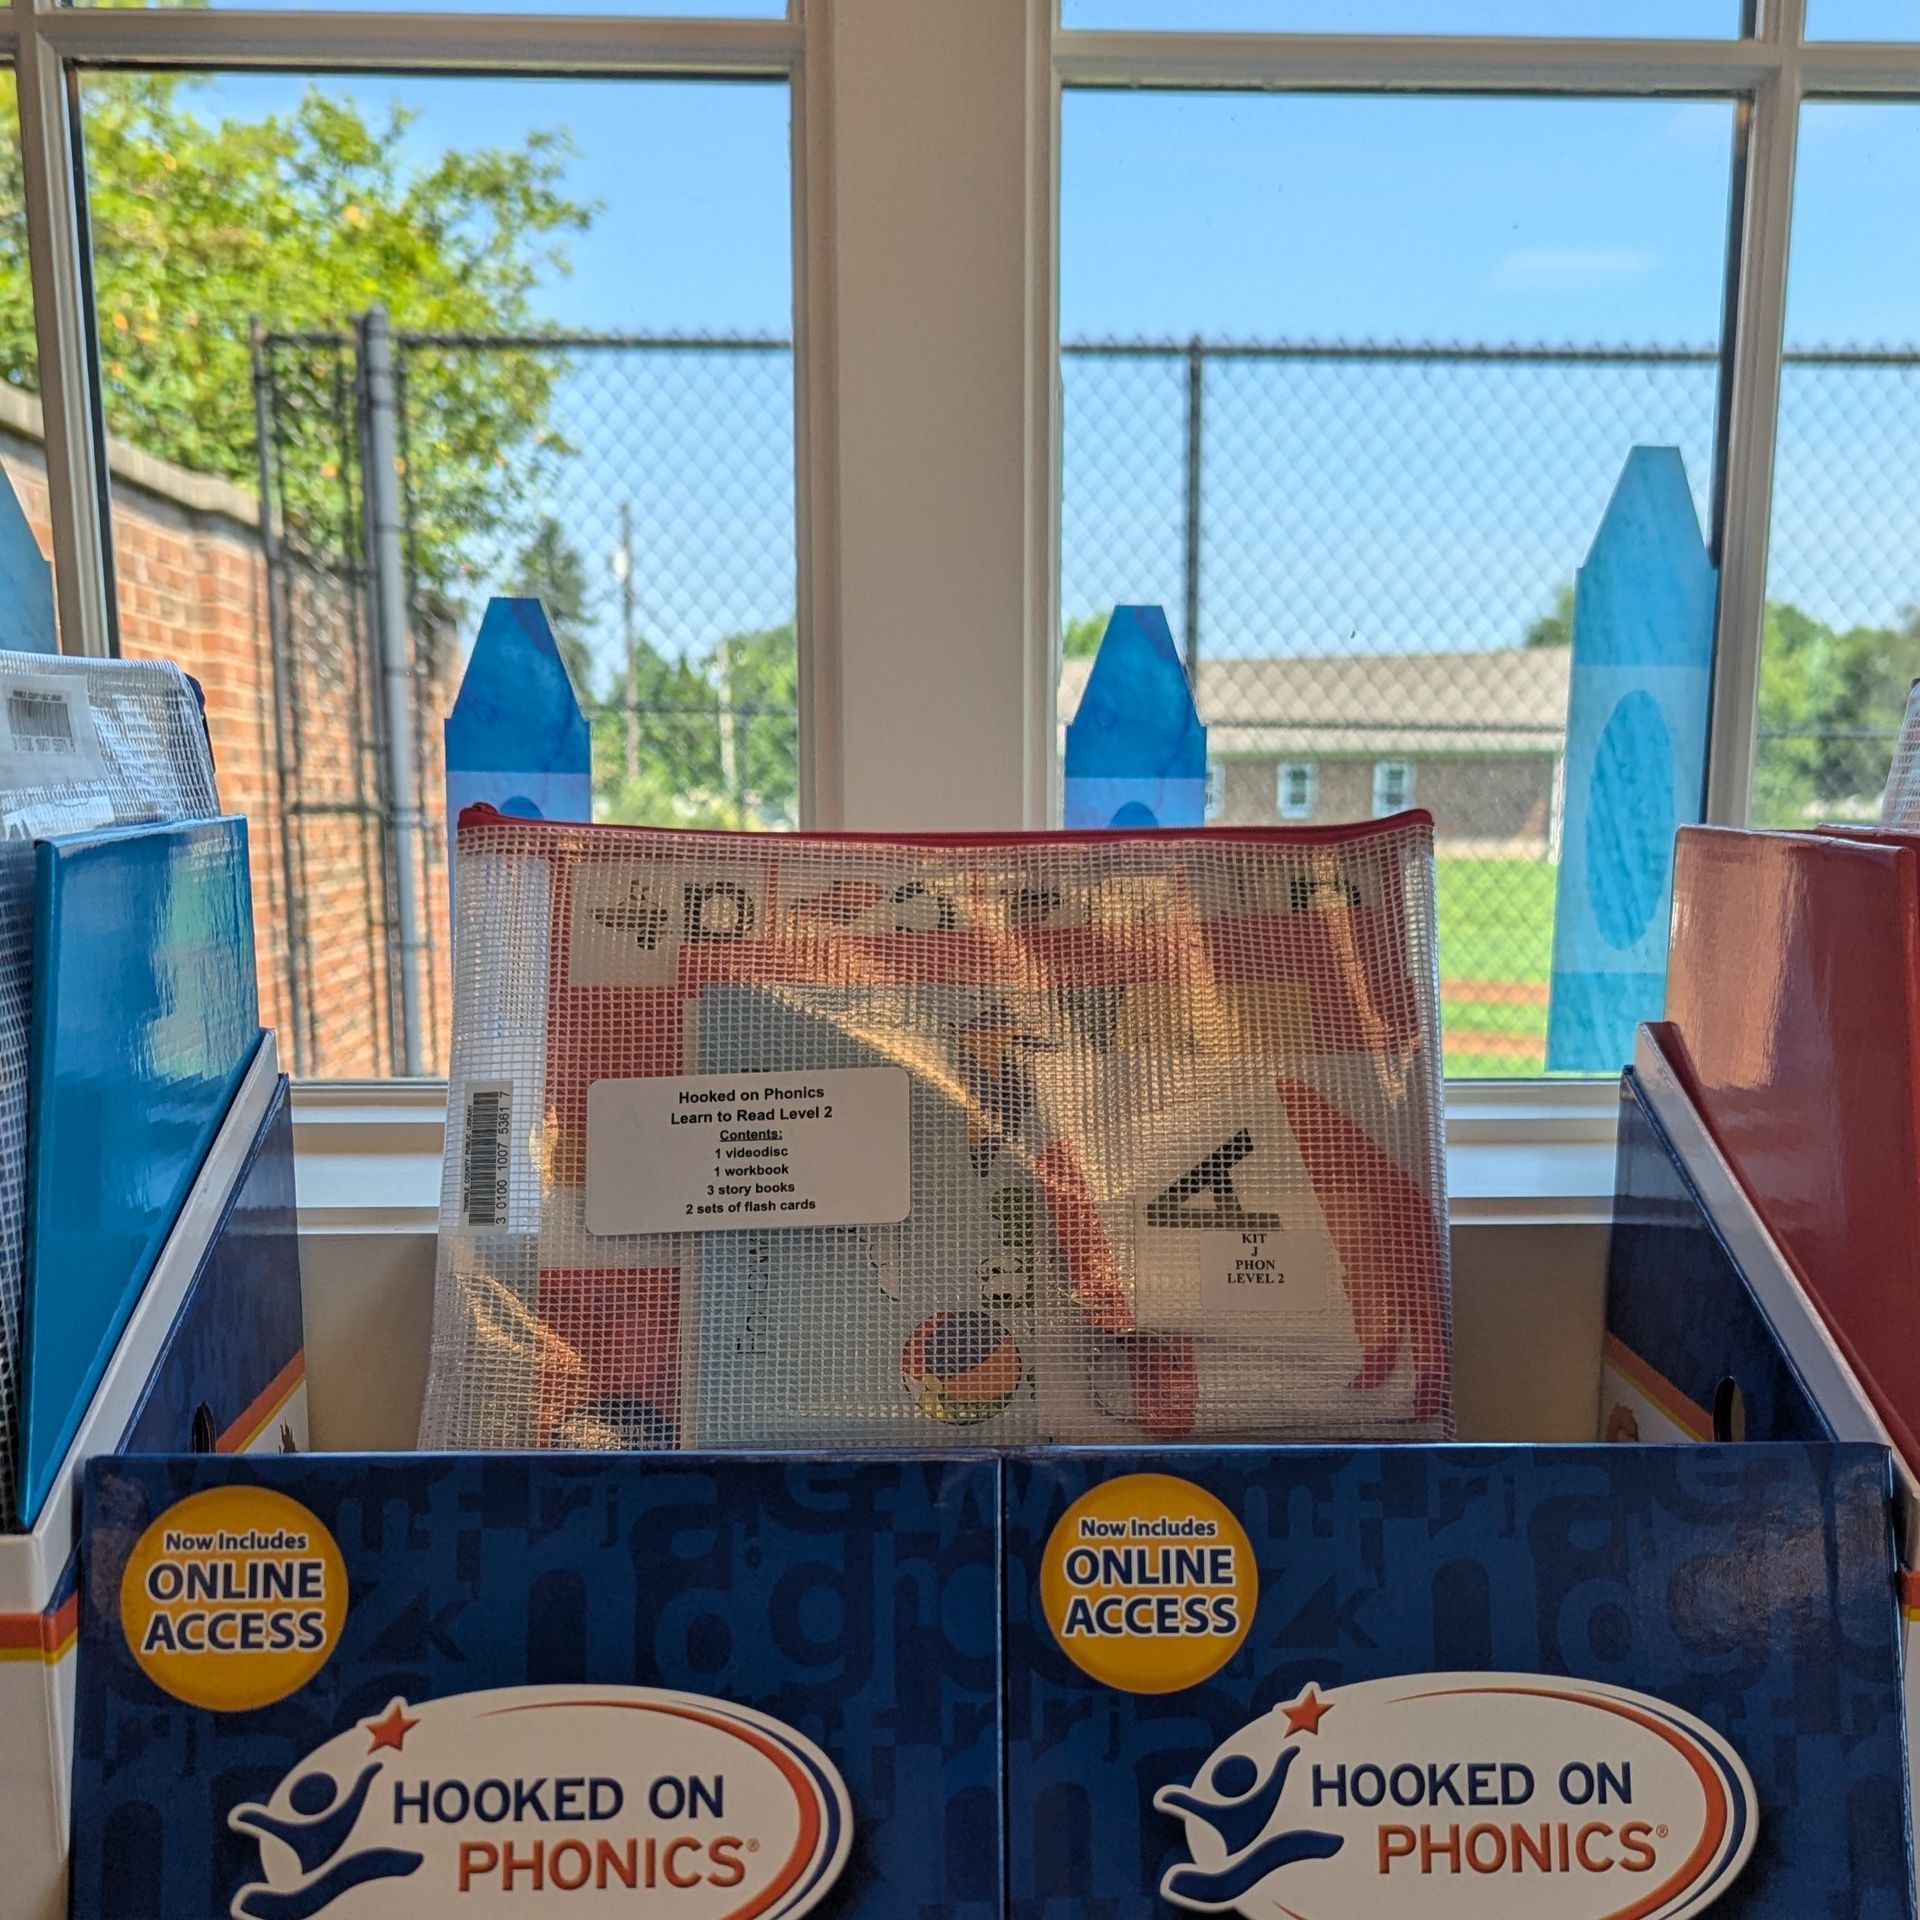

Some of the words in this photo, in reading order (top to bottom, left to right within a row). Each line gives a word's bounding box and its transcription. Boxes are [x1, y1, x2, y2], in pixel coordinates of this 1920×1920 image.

[499, 1091, 510, 1099] 7
[679, 1089, 736, 1104] Hooked
[740, 1091, 759, 1101] on
[764, 1086, 824, 1100] Phonics
[499, 1106, 509, 1134] 5361
[671, 1112, 713, 1125] Learn
[717, 1111, 732, 1122] to
[737, 1108, 775, 1122] Read
[780, 1106, 819, 1120] Level
[824, 1106, 833, 1118] 2
[720, 1129, 783, 1142] Contents:
[498, 1142, 508, 1171] 1007
[715, 1148, 721, 1159] 1
[725, 1146, 789, 1159] videodisc
[714, 1166, 720, 1177] 1
[725, 1164, 789, 1177] workbook
[497, 1180, 508, 1210] 0100
[707, 1185, 714, 1195] 3
[718, 1184, 751, 1196] story
[755, 1182, 795, 1193] books
[686, 1204, 693, 1215] 2
[697, 1203, 724, 1214] sets
[728, 1201, 742, 1213] of
[744, 1201, 776, 1213] flash
[780, 1199, 816, 1210] cards
[496, 1216, 507, 1225] 3
[1242, 1233, 1267, 1244] KIT
[1251, 1247, 1258, 1257] J
[1235, 1259, 1275, 1271] PHON
[1227, 1273, 1274, 1284] LEVEL
[1278, 1273, 1285, 1284] 2
[1080, 1518, 1126, 1538] Now
[1131, 1516, 1216, 1538] Includes
[165, 1532, 214, 1552] Now
[217, 1531, 308, 1551] Includes
[1065, 1546, 1234, 1587] ONLINE
[146, 1562, 324, 1600] ONLINE
[1062, 1597, 1238, 1636] ACCESS
[142, 1612, 325, 1652] ACCESS
[1311, 1763, 1536, 1808] HOOKED
[1559, 1762, 1631, 1804] ON
[393, 1776, 625, 1825] HOOKED
[648, 1774, 724, 1820] ON
